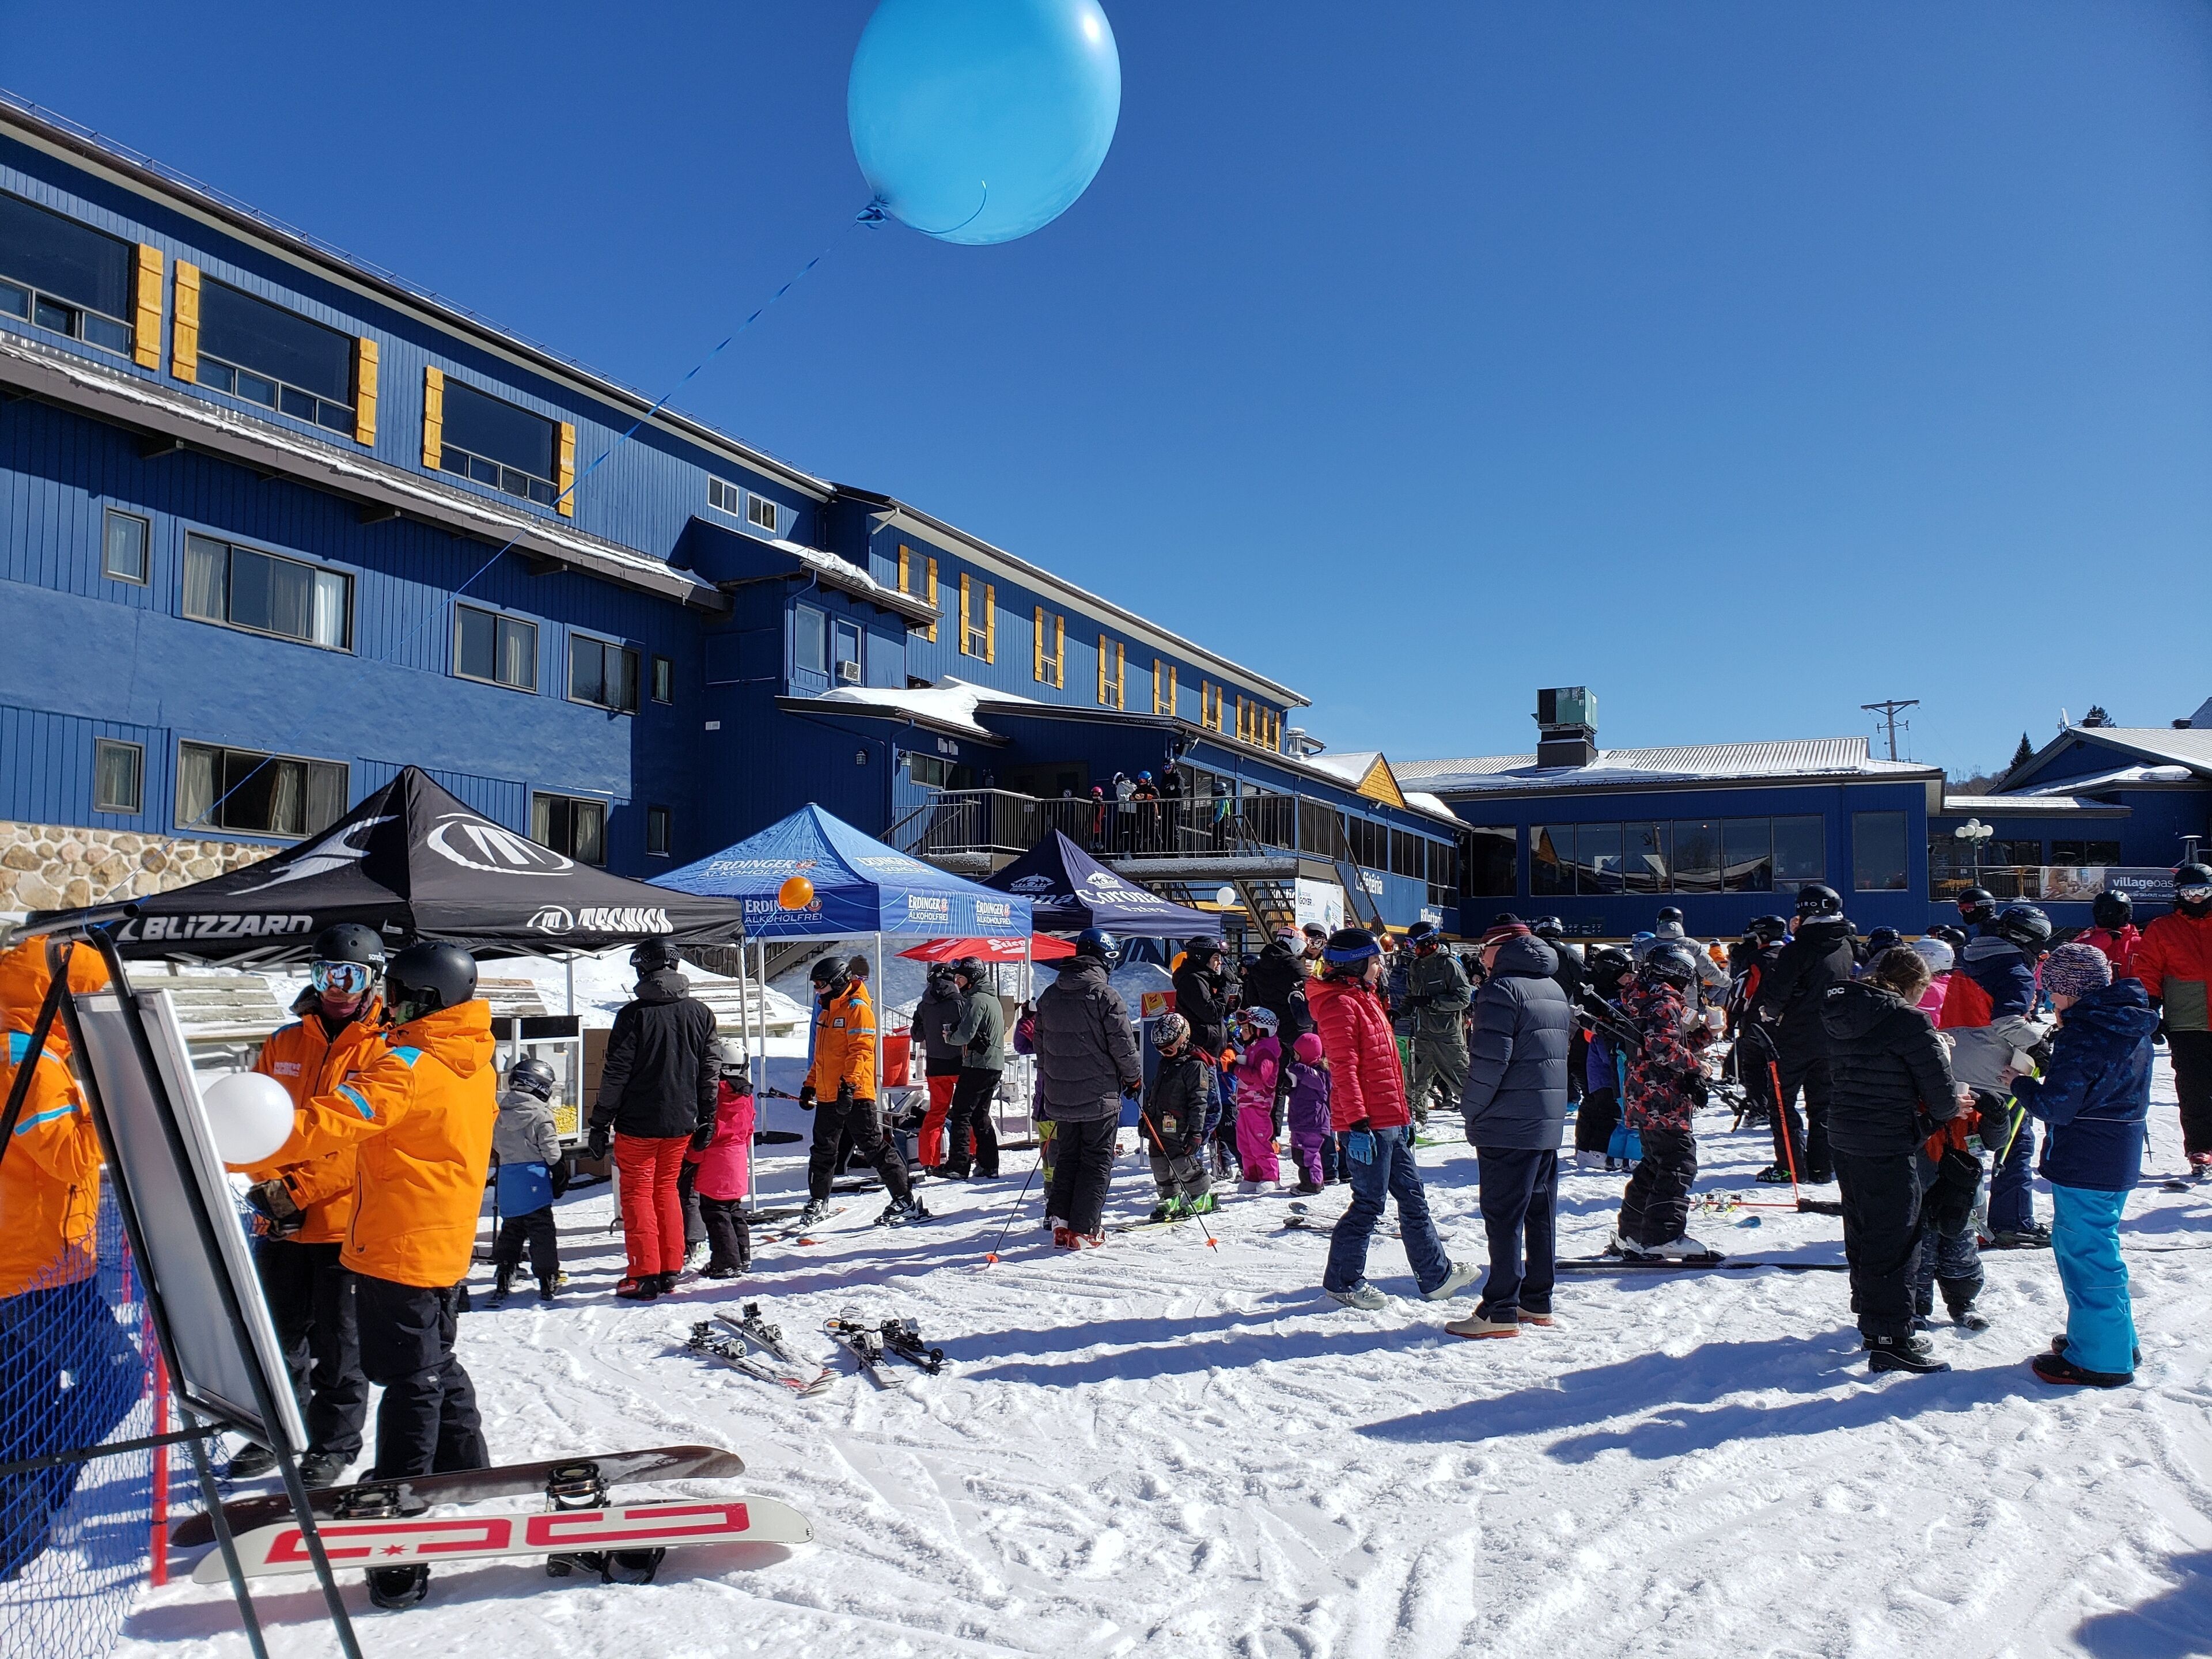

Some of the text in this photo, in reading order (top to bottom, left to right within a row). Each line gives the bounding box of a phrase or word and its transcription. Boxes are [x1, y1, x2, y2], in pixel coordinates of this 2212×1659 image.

[707, 859, 796, 870] ERDINGER
[908, 894, 941, 911] ERDINGER
[1075, 889, 1165, 905] Corona
[976, 900, 1004, 916] ERDINGER
[578, 908, 673, 933] TECNICA
[744, 912, 823, 923] ALKOHOLFREI
[908, 911, 948, 921] ALKOHOLFREI
[976, 915, 1010, 925] ALKOHOLFREI
[987, 938, 1032, 951] Stieg
